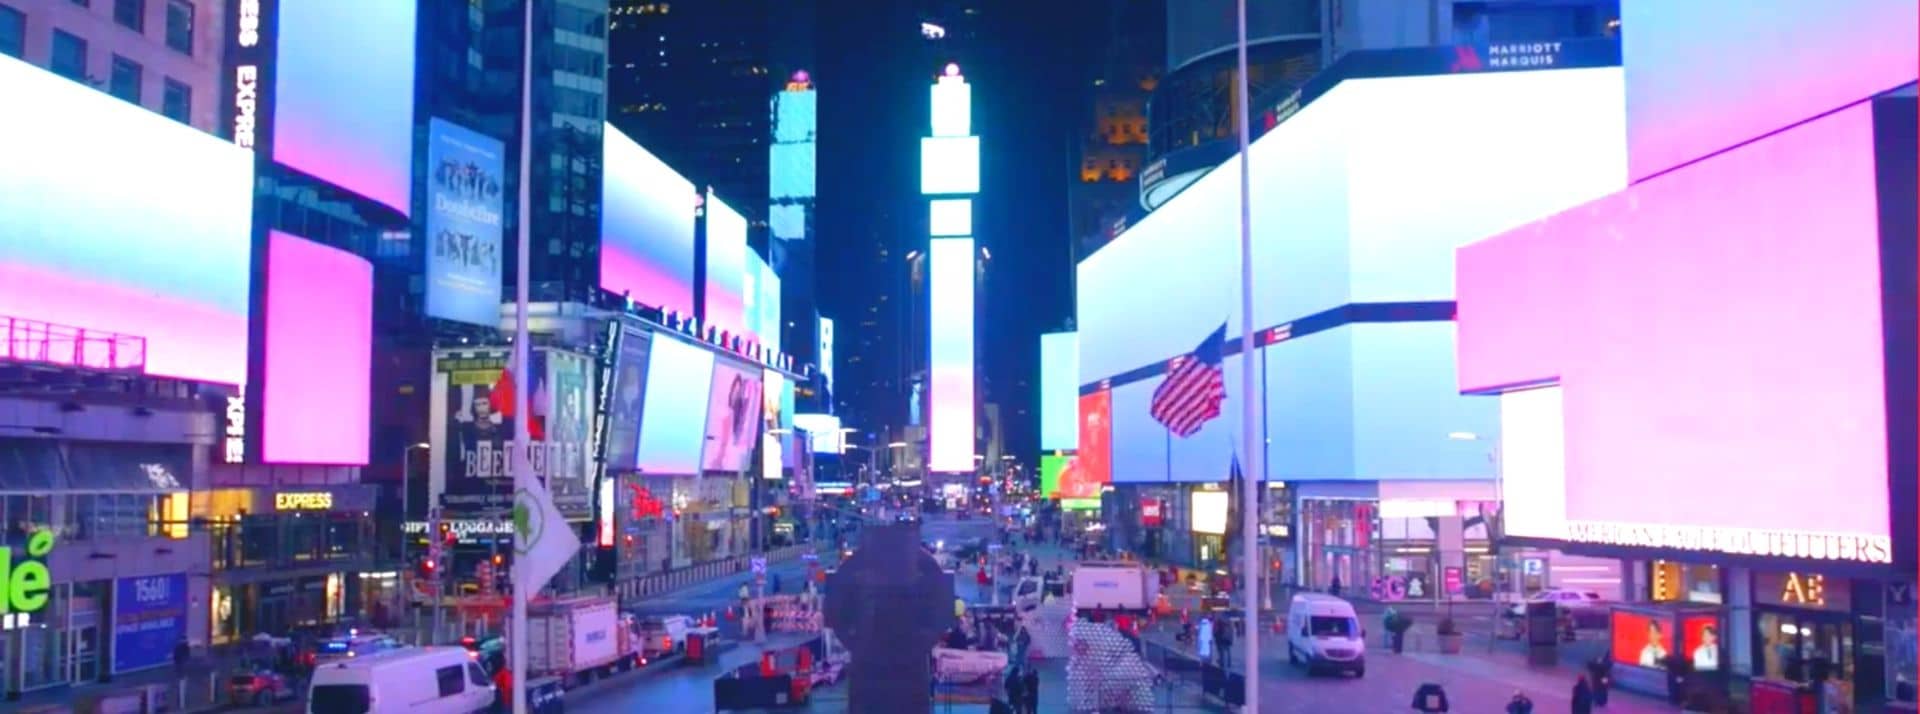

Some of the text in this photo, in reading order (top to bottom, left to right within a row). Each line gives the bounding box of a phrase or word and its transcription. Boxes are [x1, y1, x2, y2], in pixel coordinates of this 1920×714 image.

[1488, 43, 1561, 55] MARRIOTT
[1489, 56, 1553, 67] MARQUIS
[276, 492, 332, 510] EXPRESS
[1783, 571, 1824, 605] AE
